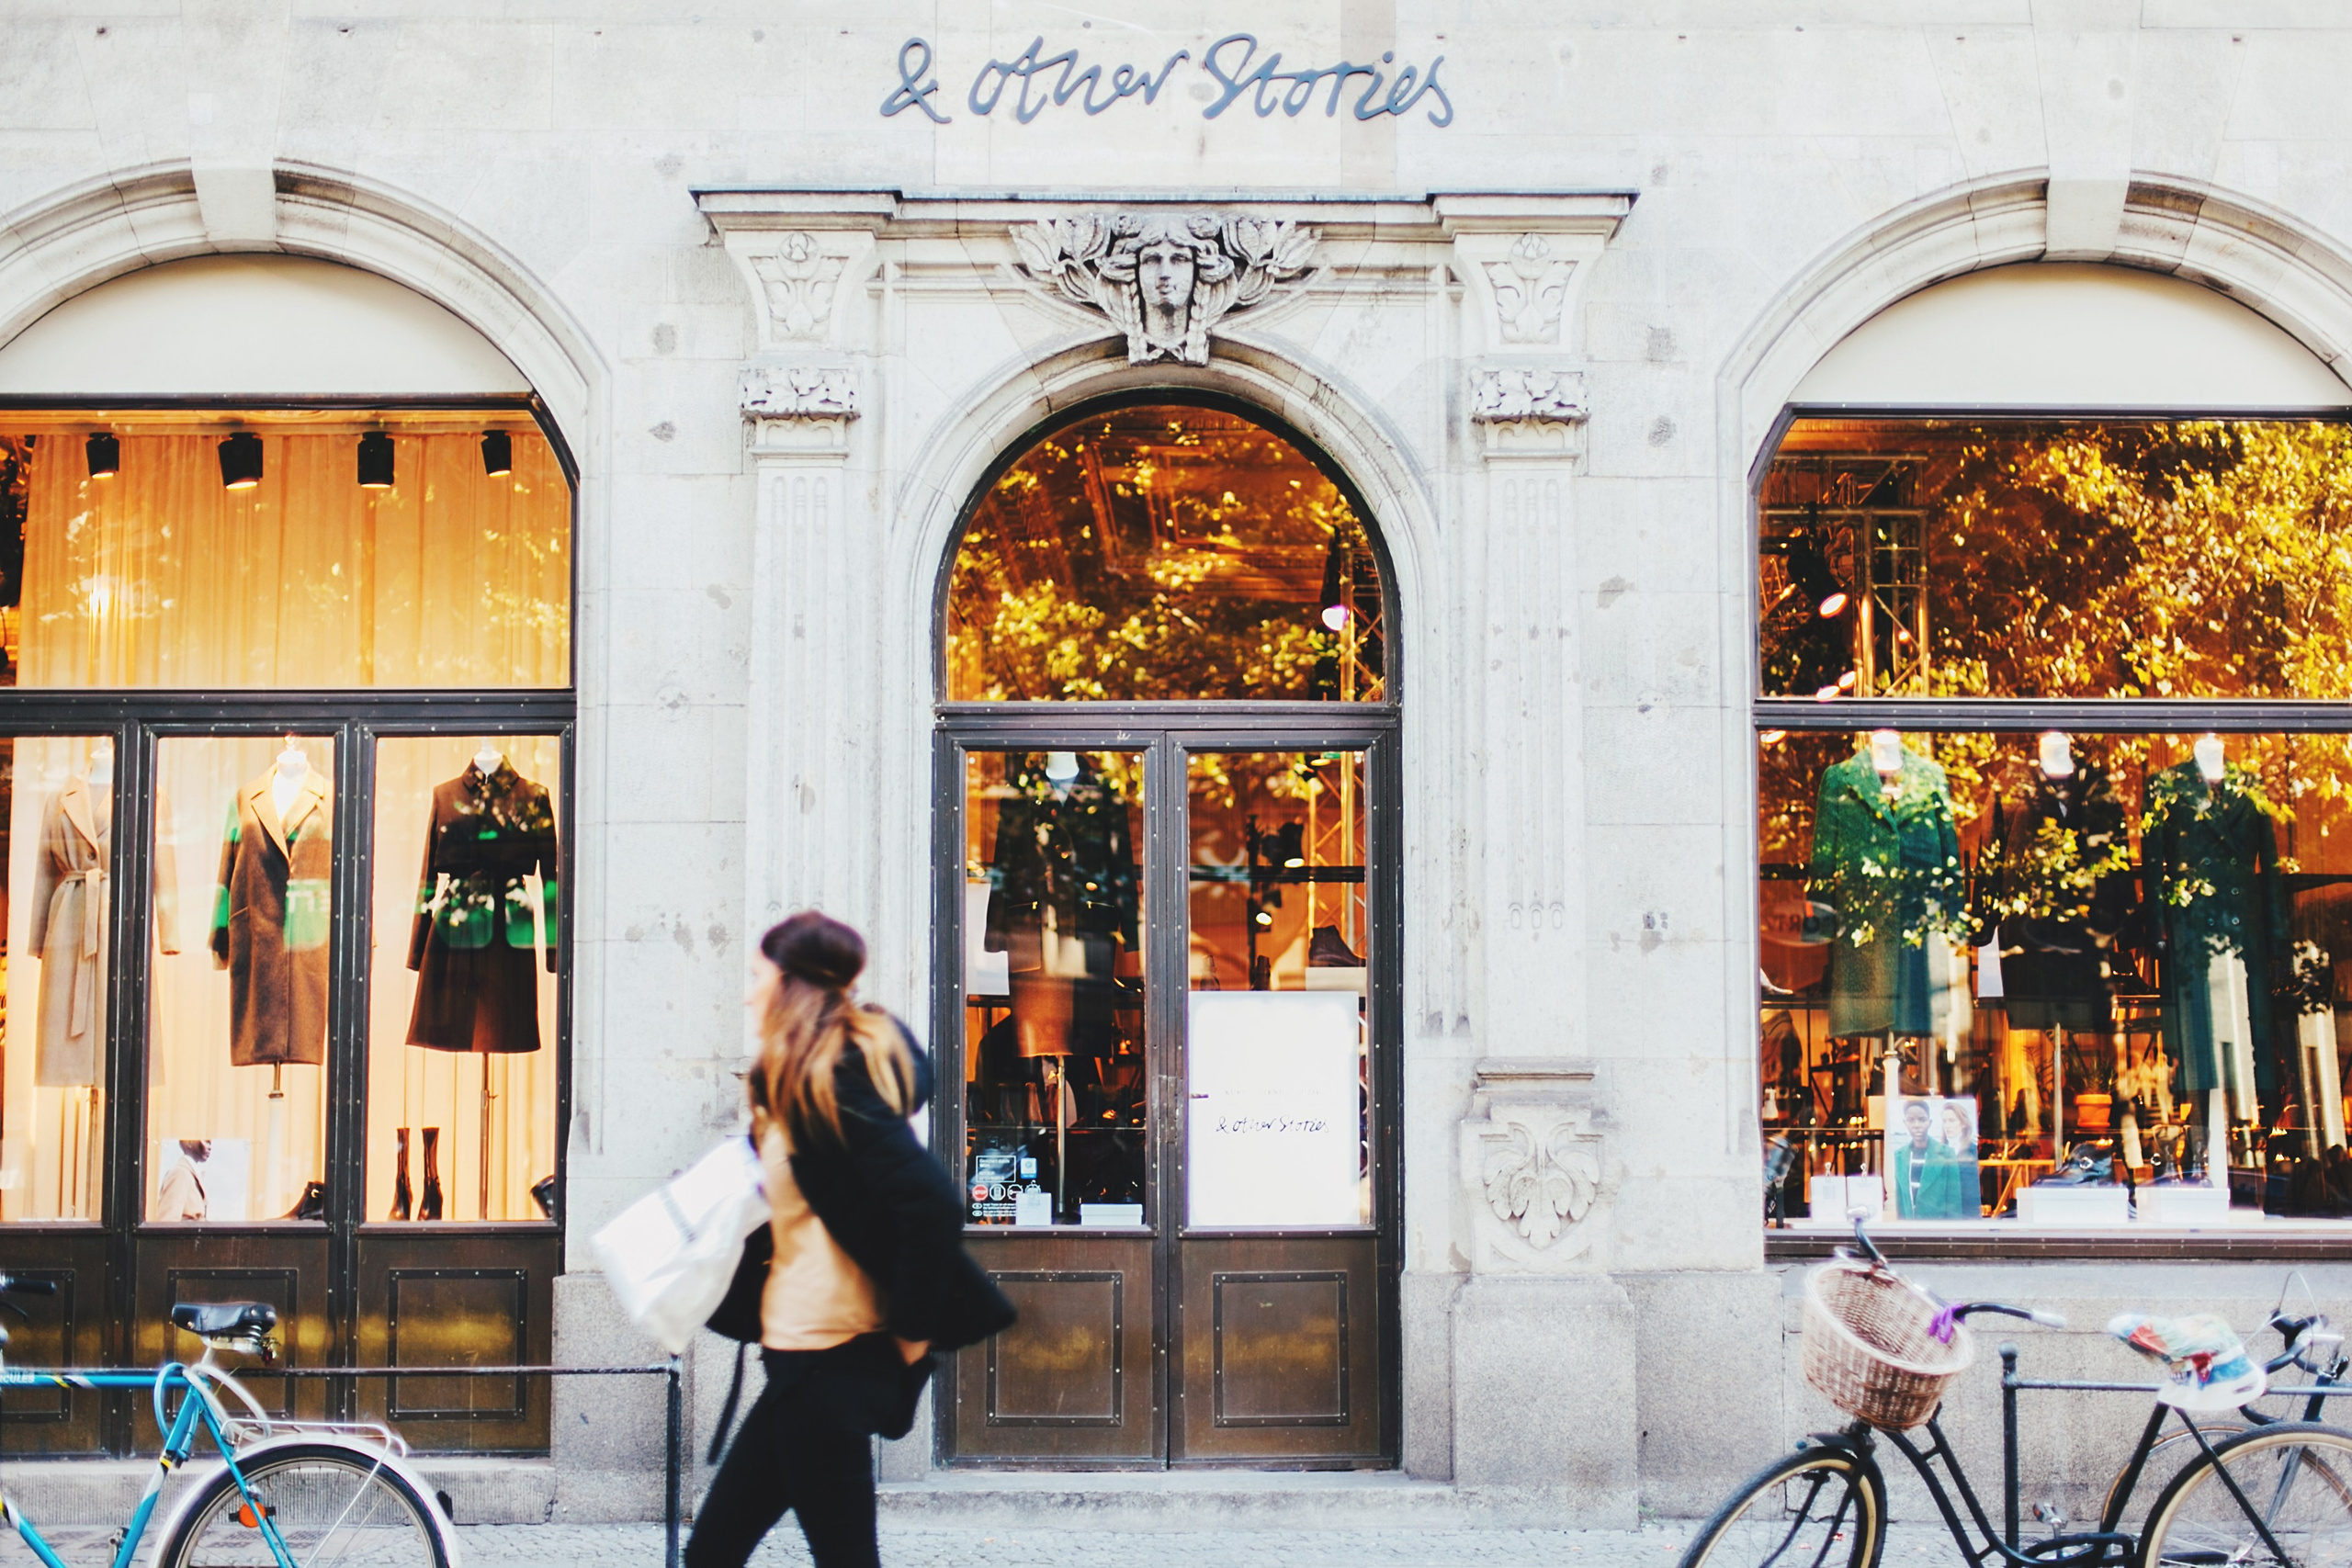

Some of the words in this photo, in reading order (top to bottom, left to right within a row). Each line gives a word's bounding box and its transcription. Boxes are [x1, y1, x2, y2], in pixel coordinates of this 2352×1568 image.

[879, 36, 952, 123] &
[968, 36, 1190, 124] other
[1203, 33, 1453, 127] Stories
[1216, 1115, 1229, 1134] &
[1232, 1116, 1277, 1134] other
